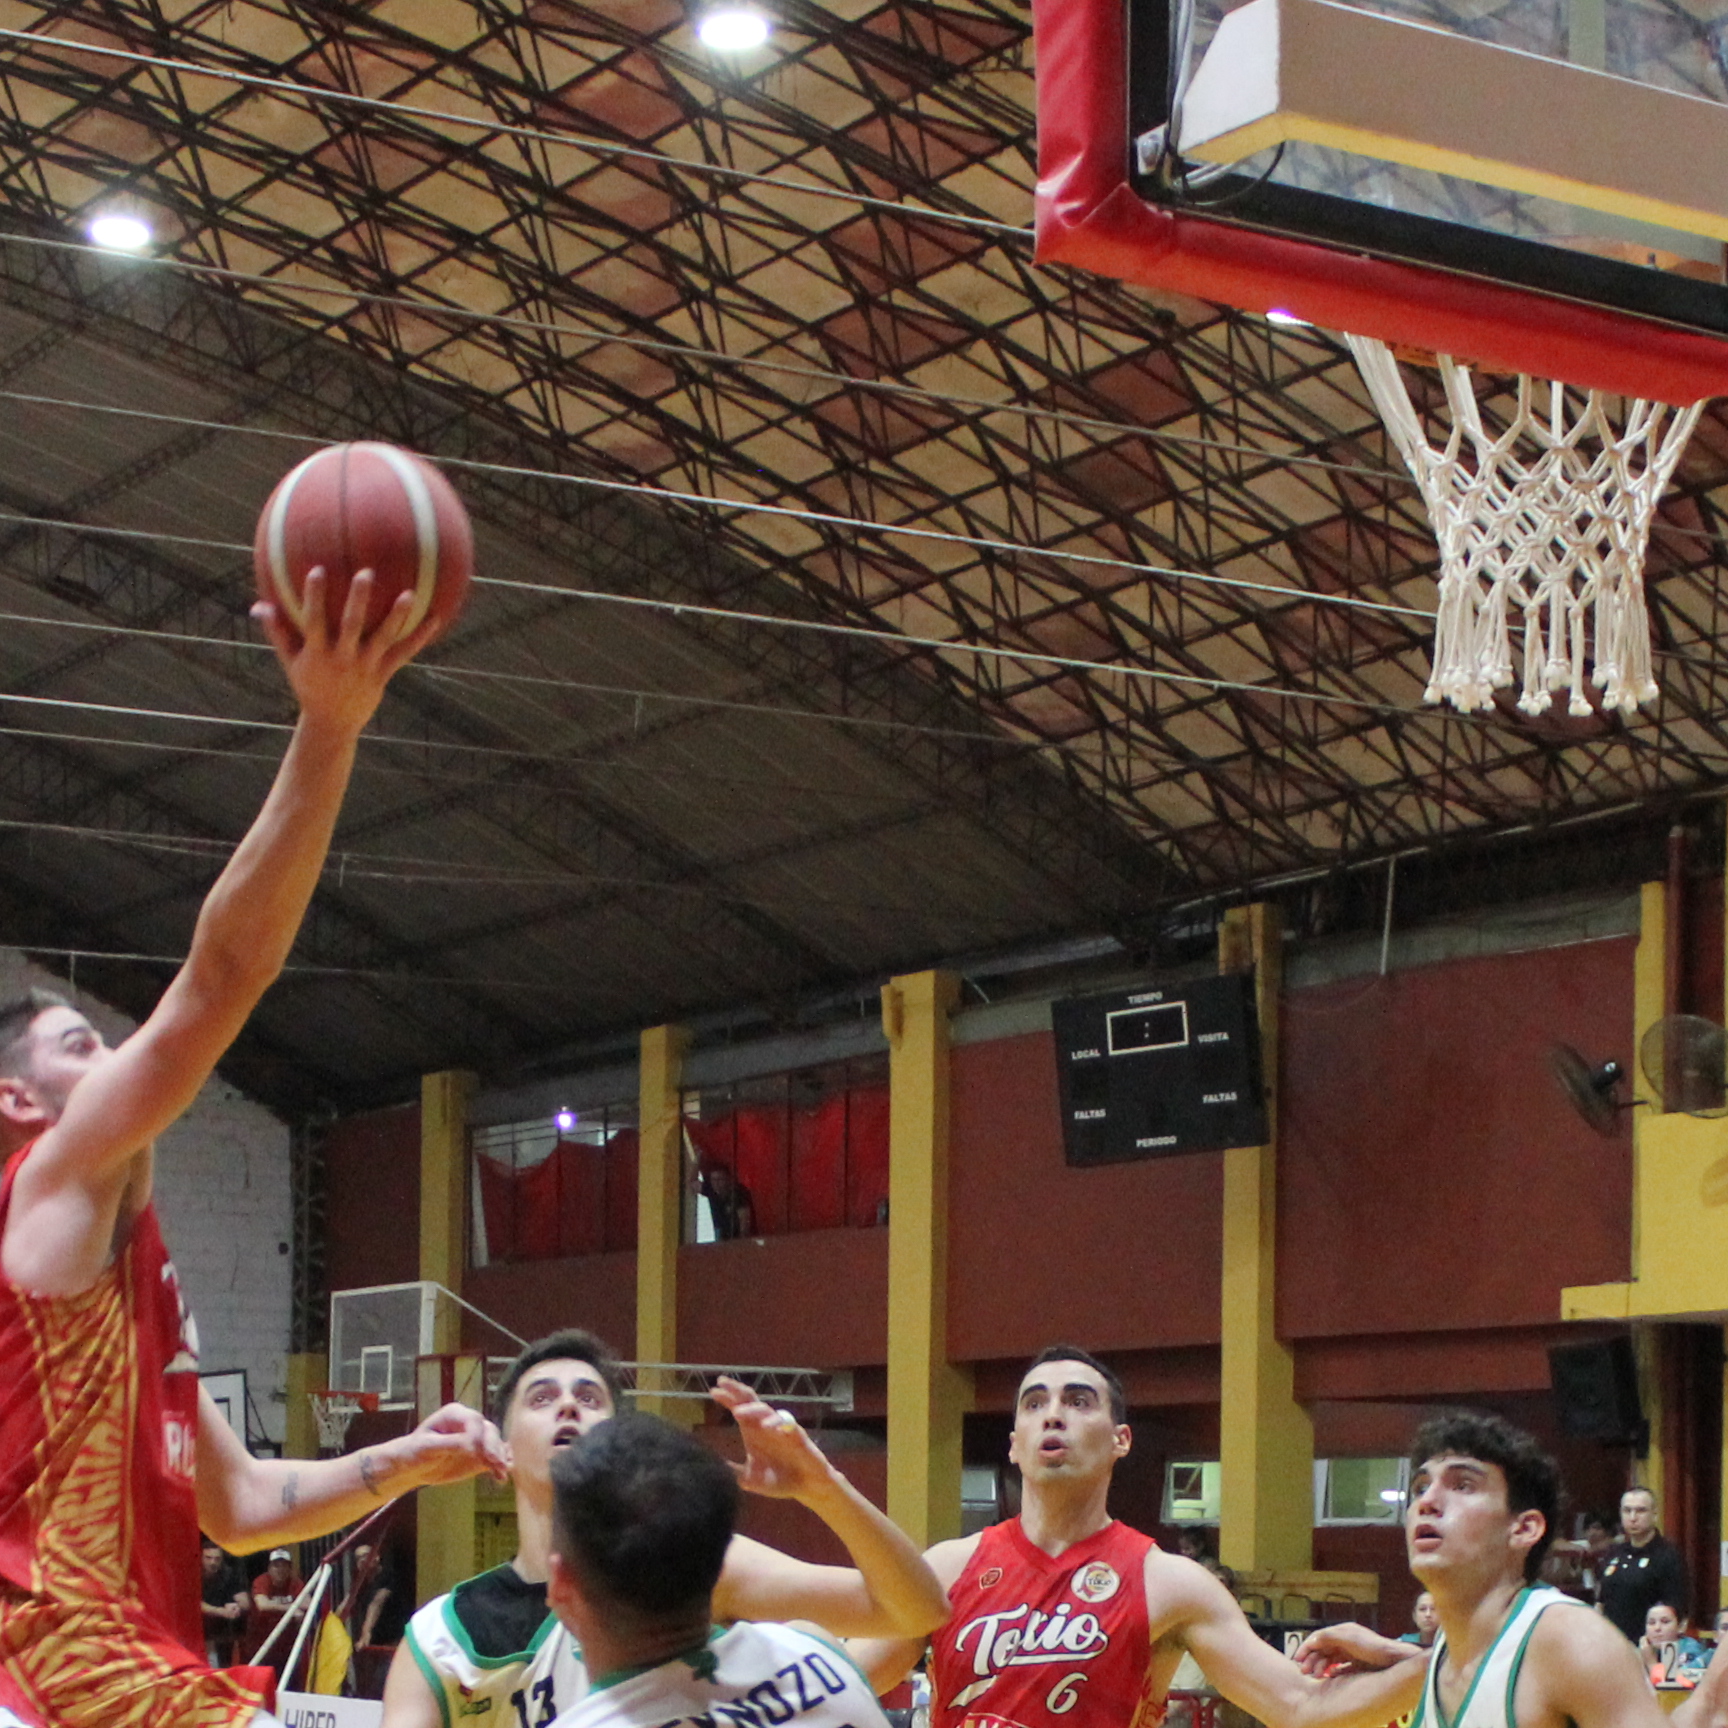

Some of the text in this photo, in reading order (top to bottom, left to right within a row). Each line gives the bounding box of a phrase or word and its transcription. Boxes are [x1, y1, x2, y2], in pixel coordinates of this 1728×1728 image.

[1127, 991, 1163, 1004] TIEMPO
[1197, 1031, 1229, 1044] VISITA
[1072, 1048, 1101, 1060] LOCAL
[1202, 1091, 1237, 1104] FALTAS
[1074, 1108, 1107, 1120] FALTAS
[1135, 1135, 1177, 1148] PERIODO
[1664, 1642, 1677, 1682] 2
[1045, 1671, 1090, 1715] 6
